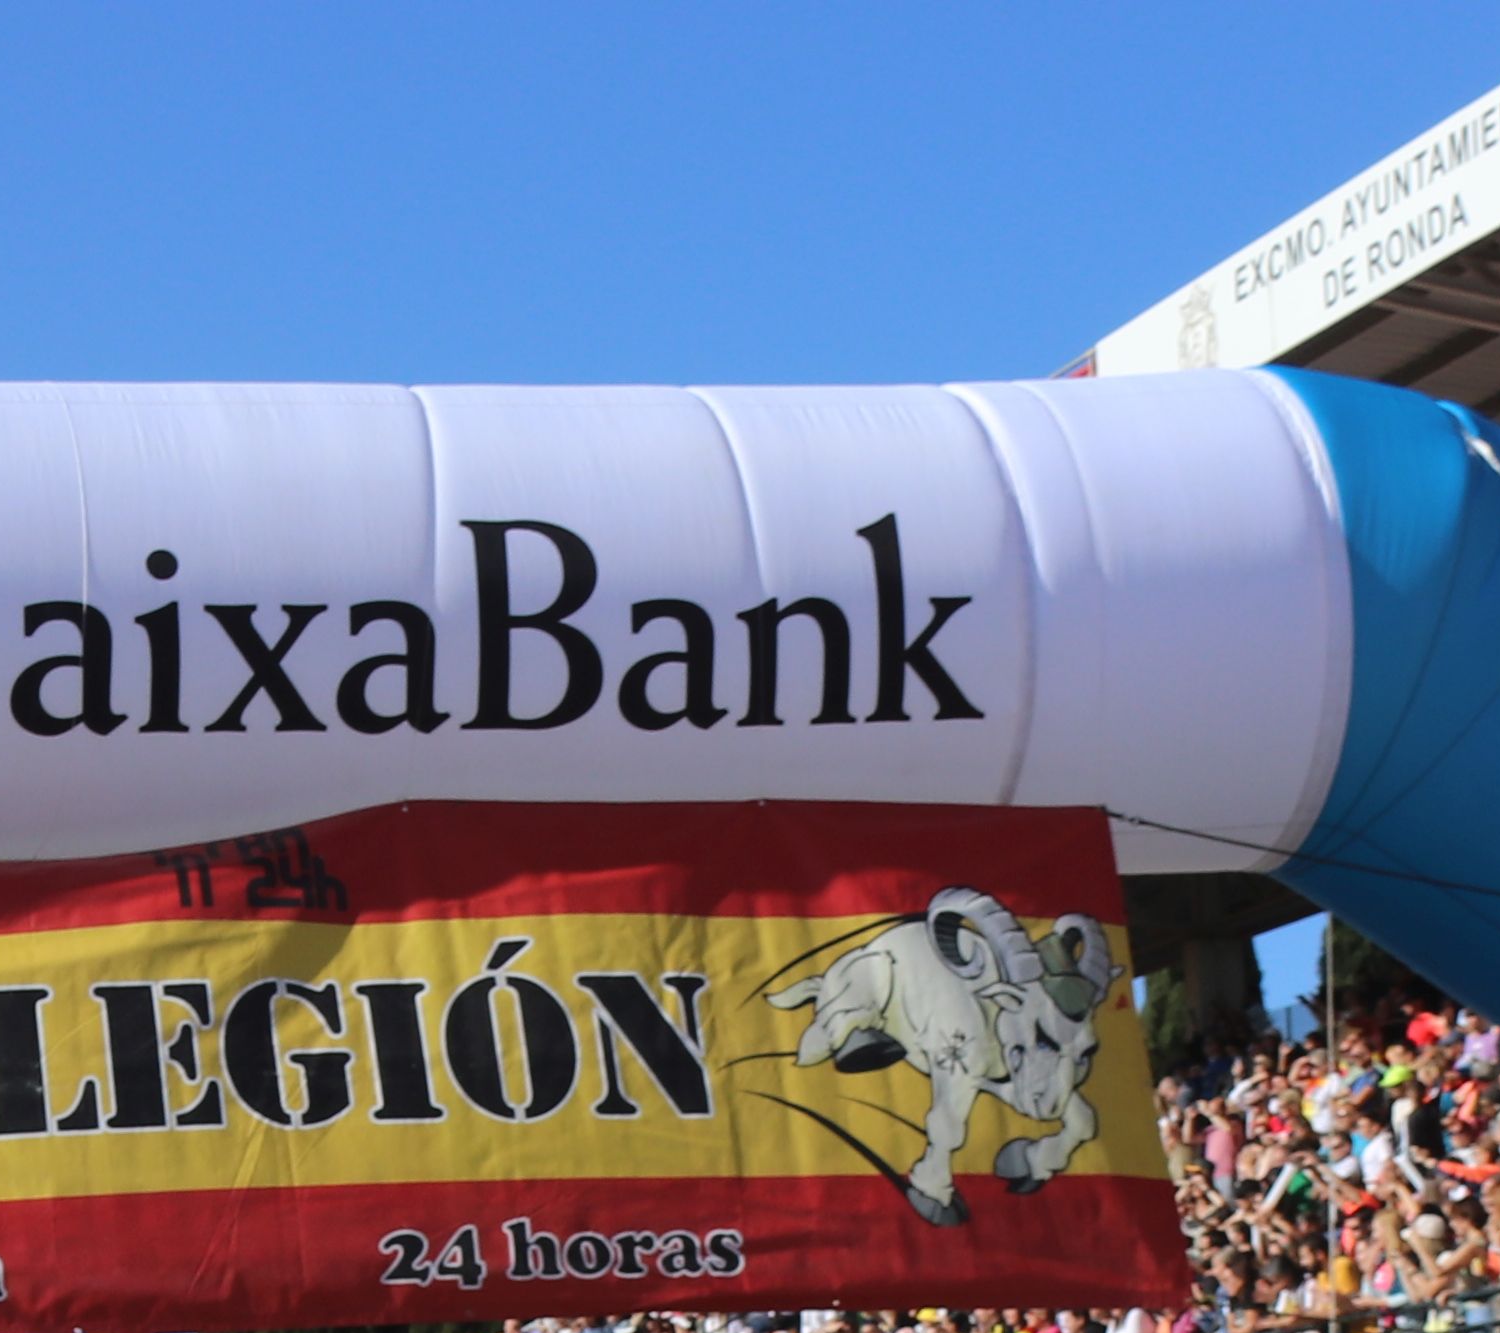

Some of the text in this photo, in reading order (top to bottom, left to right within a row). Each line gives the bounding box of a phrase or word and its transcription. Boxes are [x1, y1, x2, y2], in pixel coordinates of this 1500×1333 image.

[1233, 218, 1335, 302] EXCMO.
[1322, 193, 1470, 310] DE RONDA
[378, 1216, 746, 1290] 24 horas
